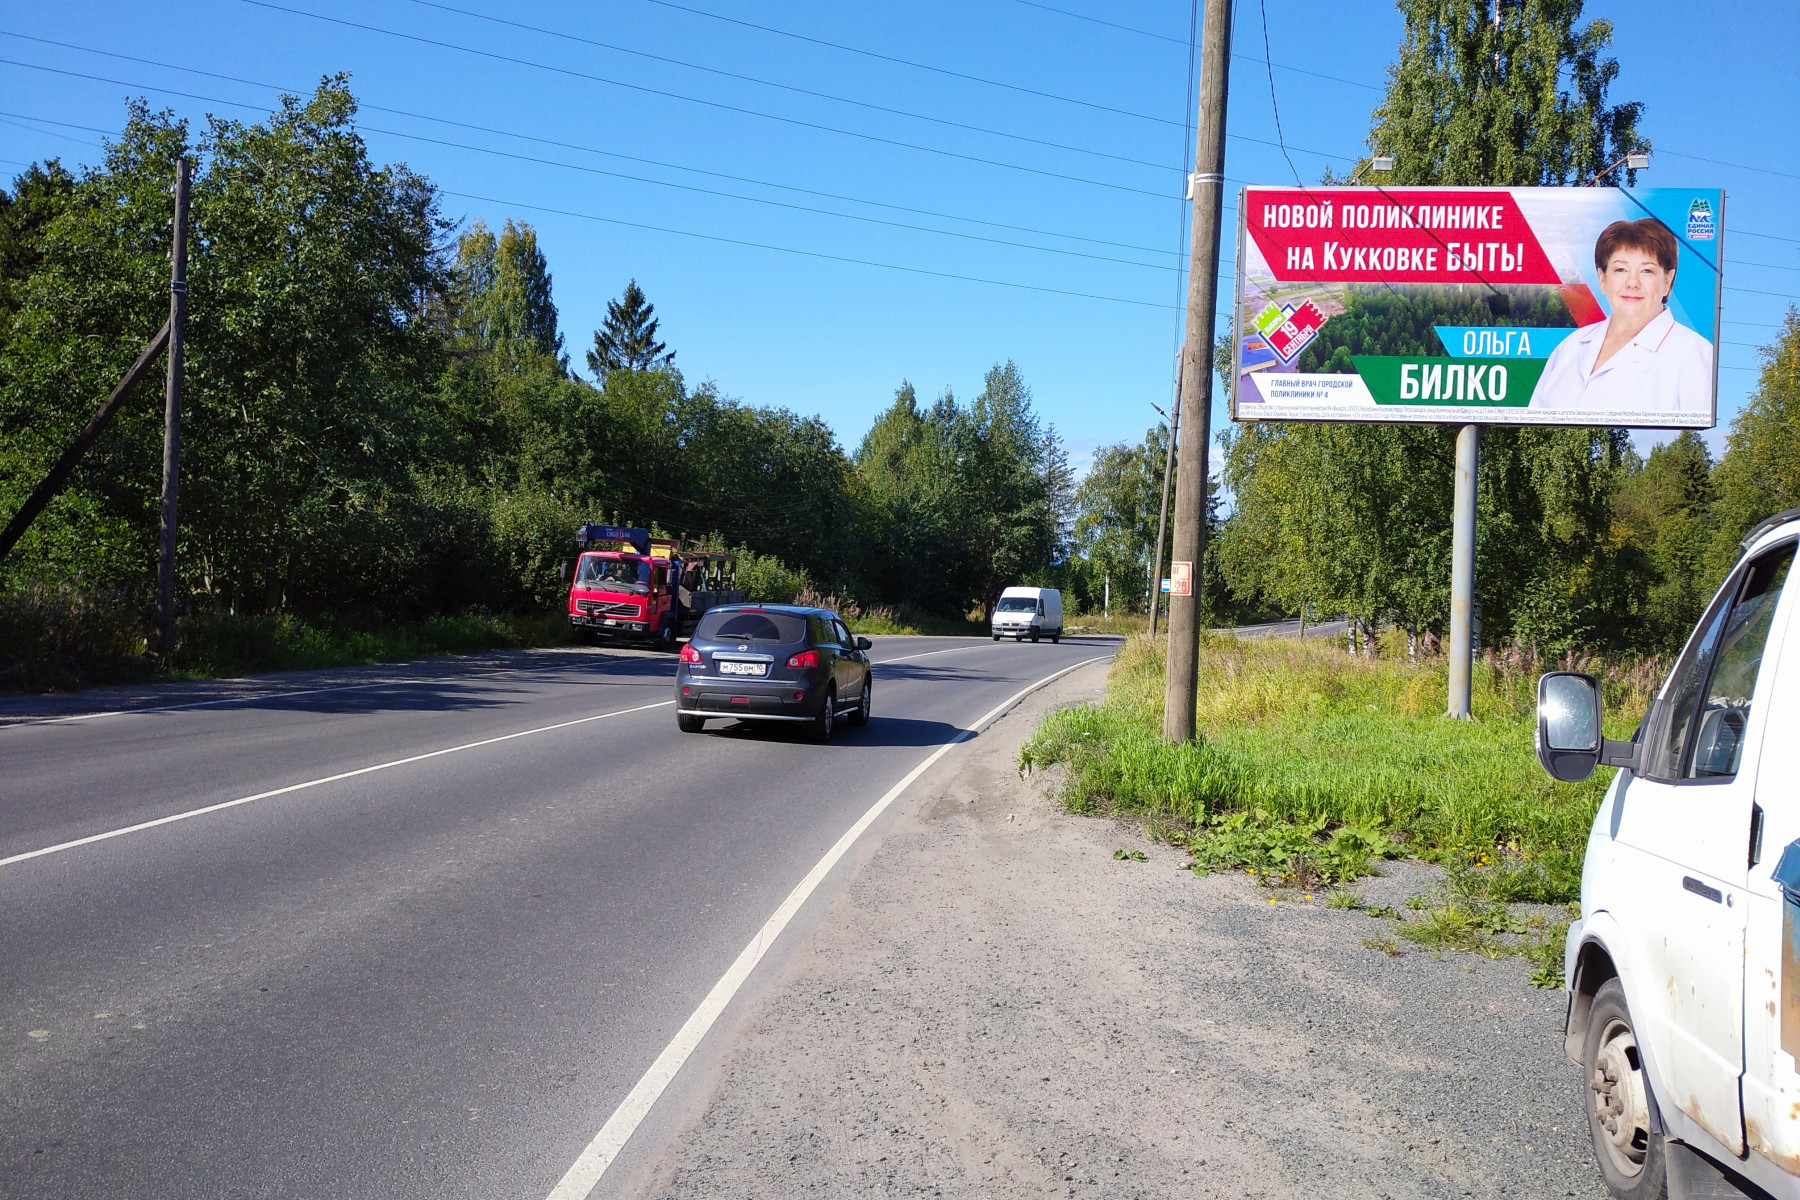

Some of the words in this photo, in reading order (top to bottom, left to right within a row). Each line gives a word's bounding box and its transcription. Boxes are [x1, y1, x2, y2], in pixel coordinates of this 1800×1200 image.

[1264, 200, 1333, 228] НОВОЙ
[1342, 205, 1504, 229] ПОЛИКЛИНИКЕ
[1287, 246, 1315, 270] НА
[1446, 242, 1524, 272] БЫТЬ!
[1280, 320, 1299, 339] 19
[1282, 324, 1315, 355] СЕНТЯБРЯ
[1463, 330, 1531, 356] ОЛЬГА
[1270, 390, 1315, 398] ПОЛИКЛИНИКИ
[1271, 379, 1300, 388] ГЛАВНЫЙ
[1301, 380, 1317, 388] ВРАЧ
[1318, 380, 1353, 388] ГОРОДСКОЙ
[1400, 363, 1508, 401] БИЛКО
